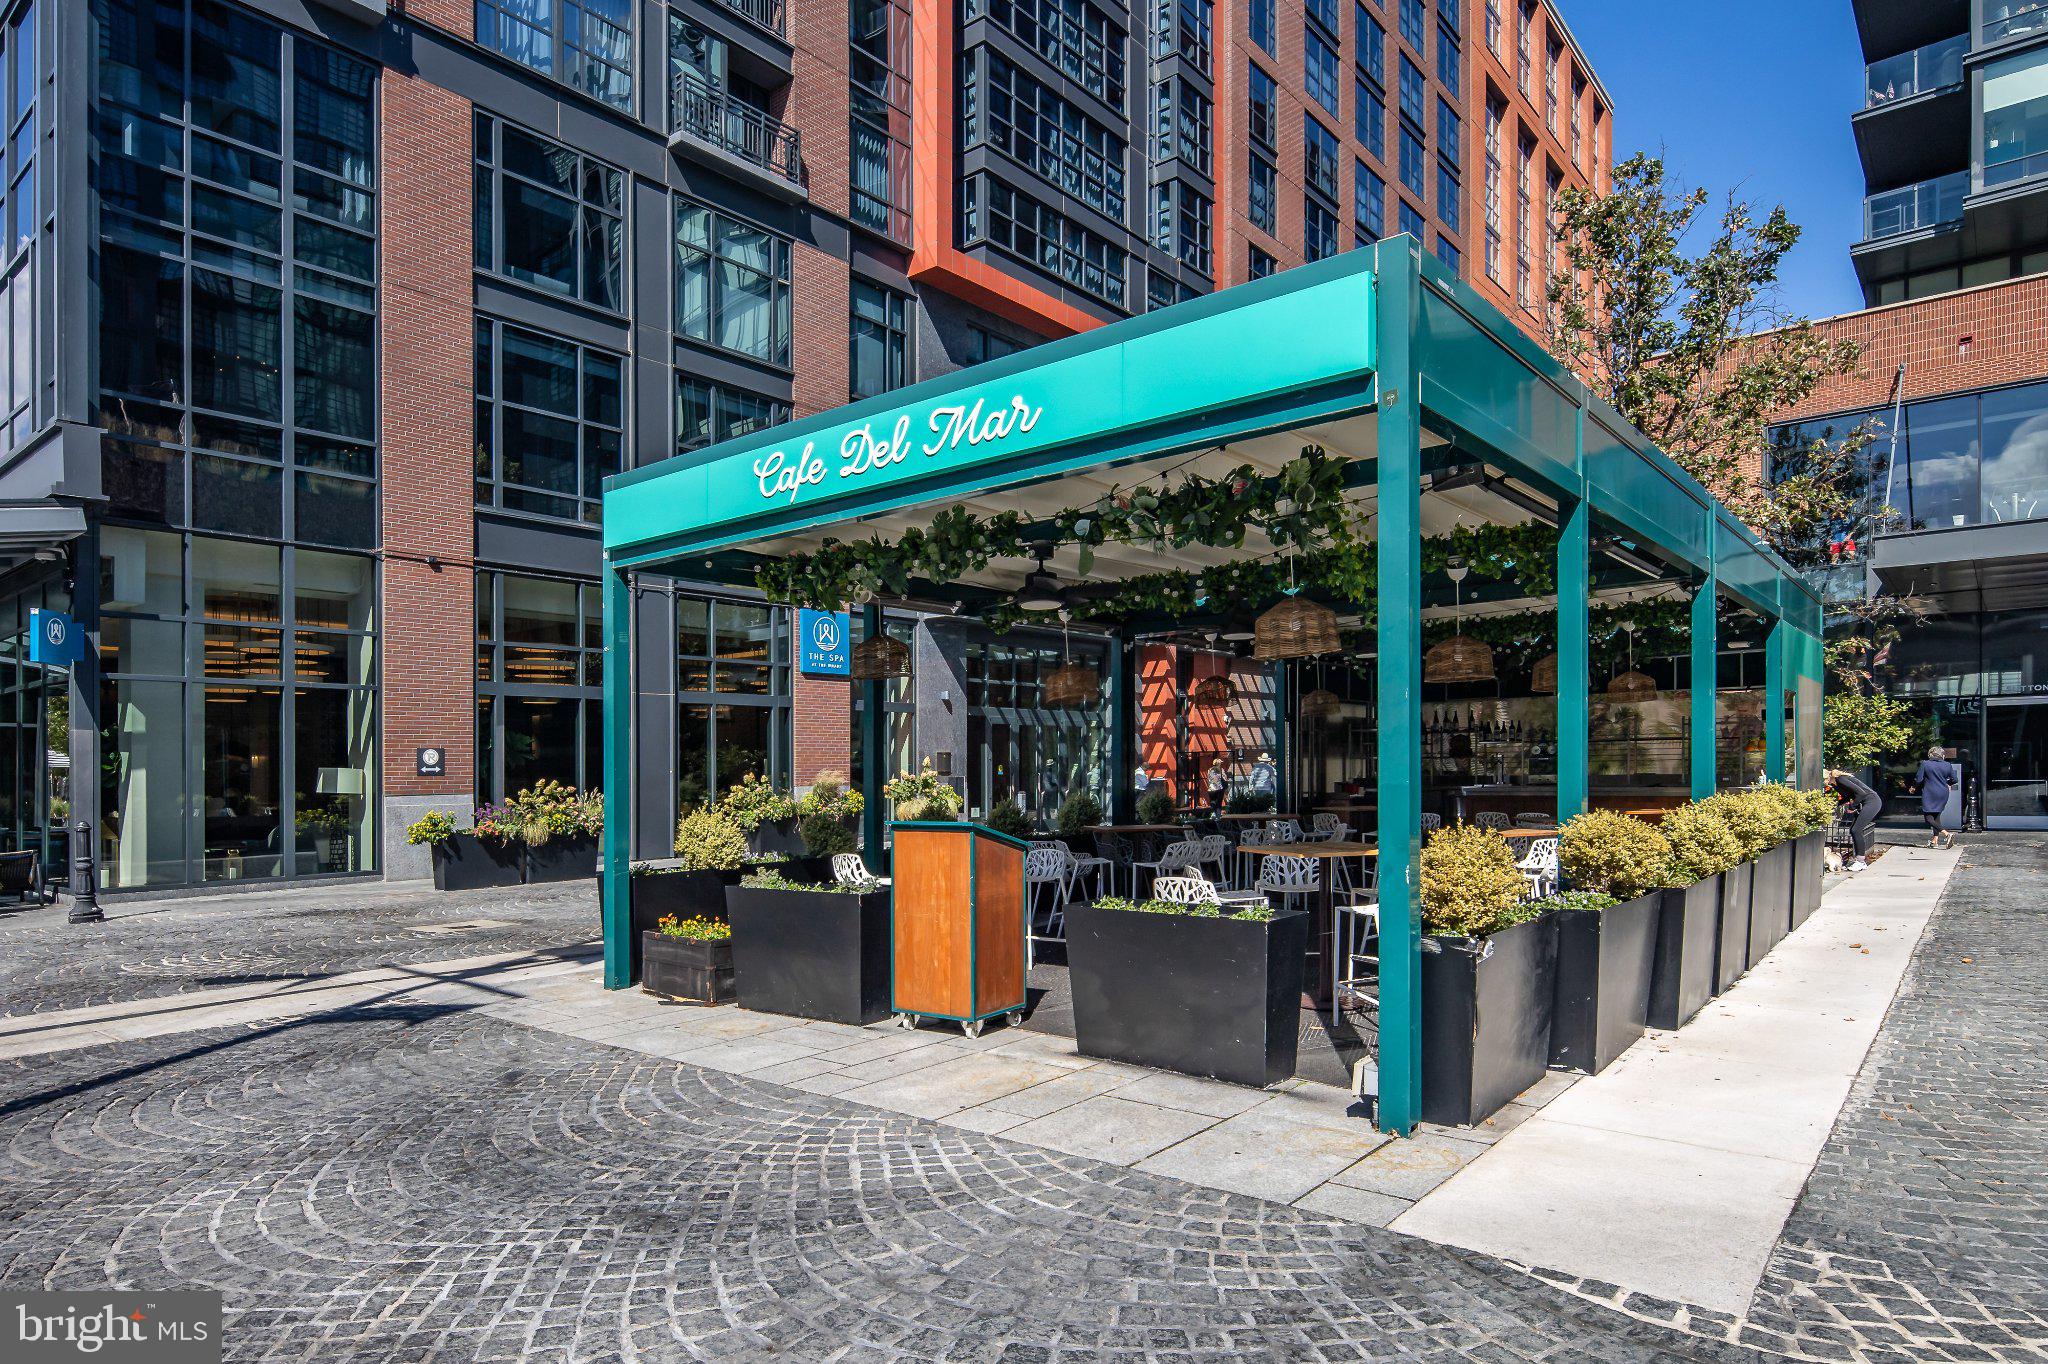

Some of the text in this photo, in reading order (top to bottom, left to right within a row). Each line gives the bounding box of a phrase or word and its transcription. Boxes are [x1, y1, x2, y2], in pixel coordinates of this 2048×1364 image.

[753, 395, 1043, 504] Cafe Del Mar
[808, 652, 845, 663] THE SPA
